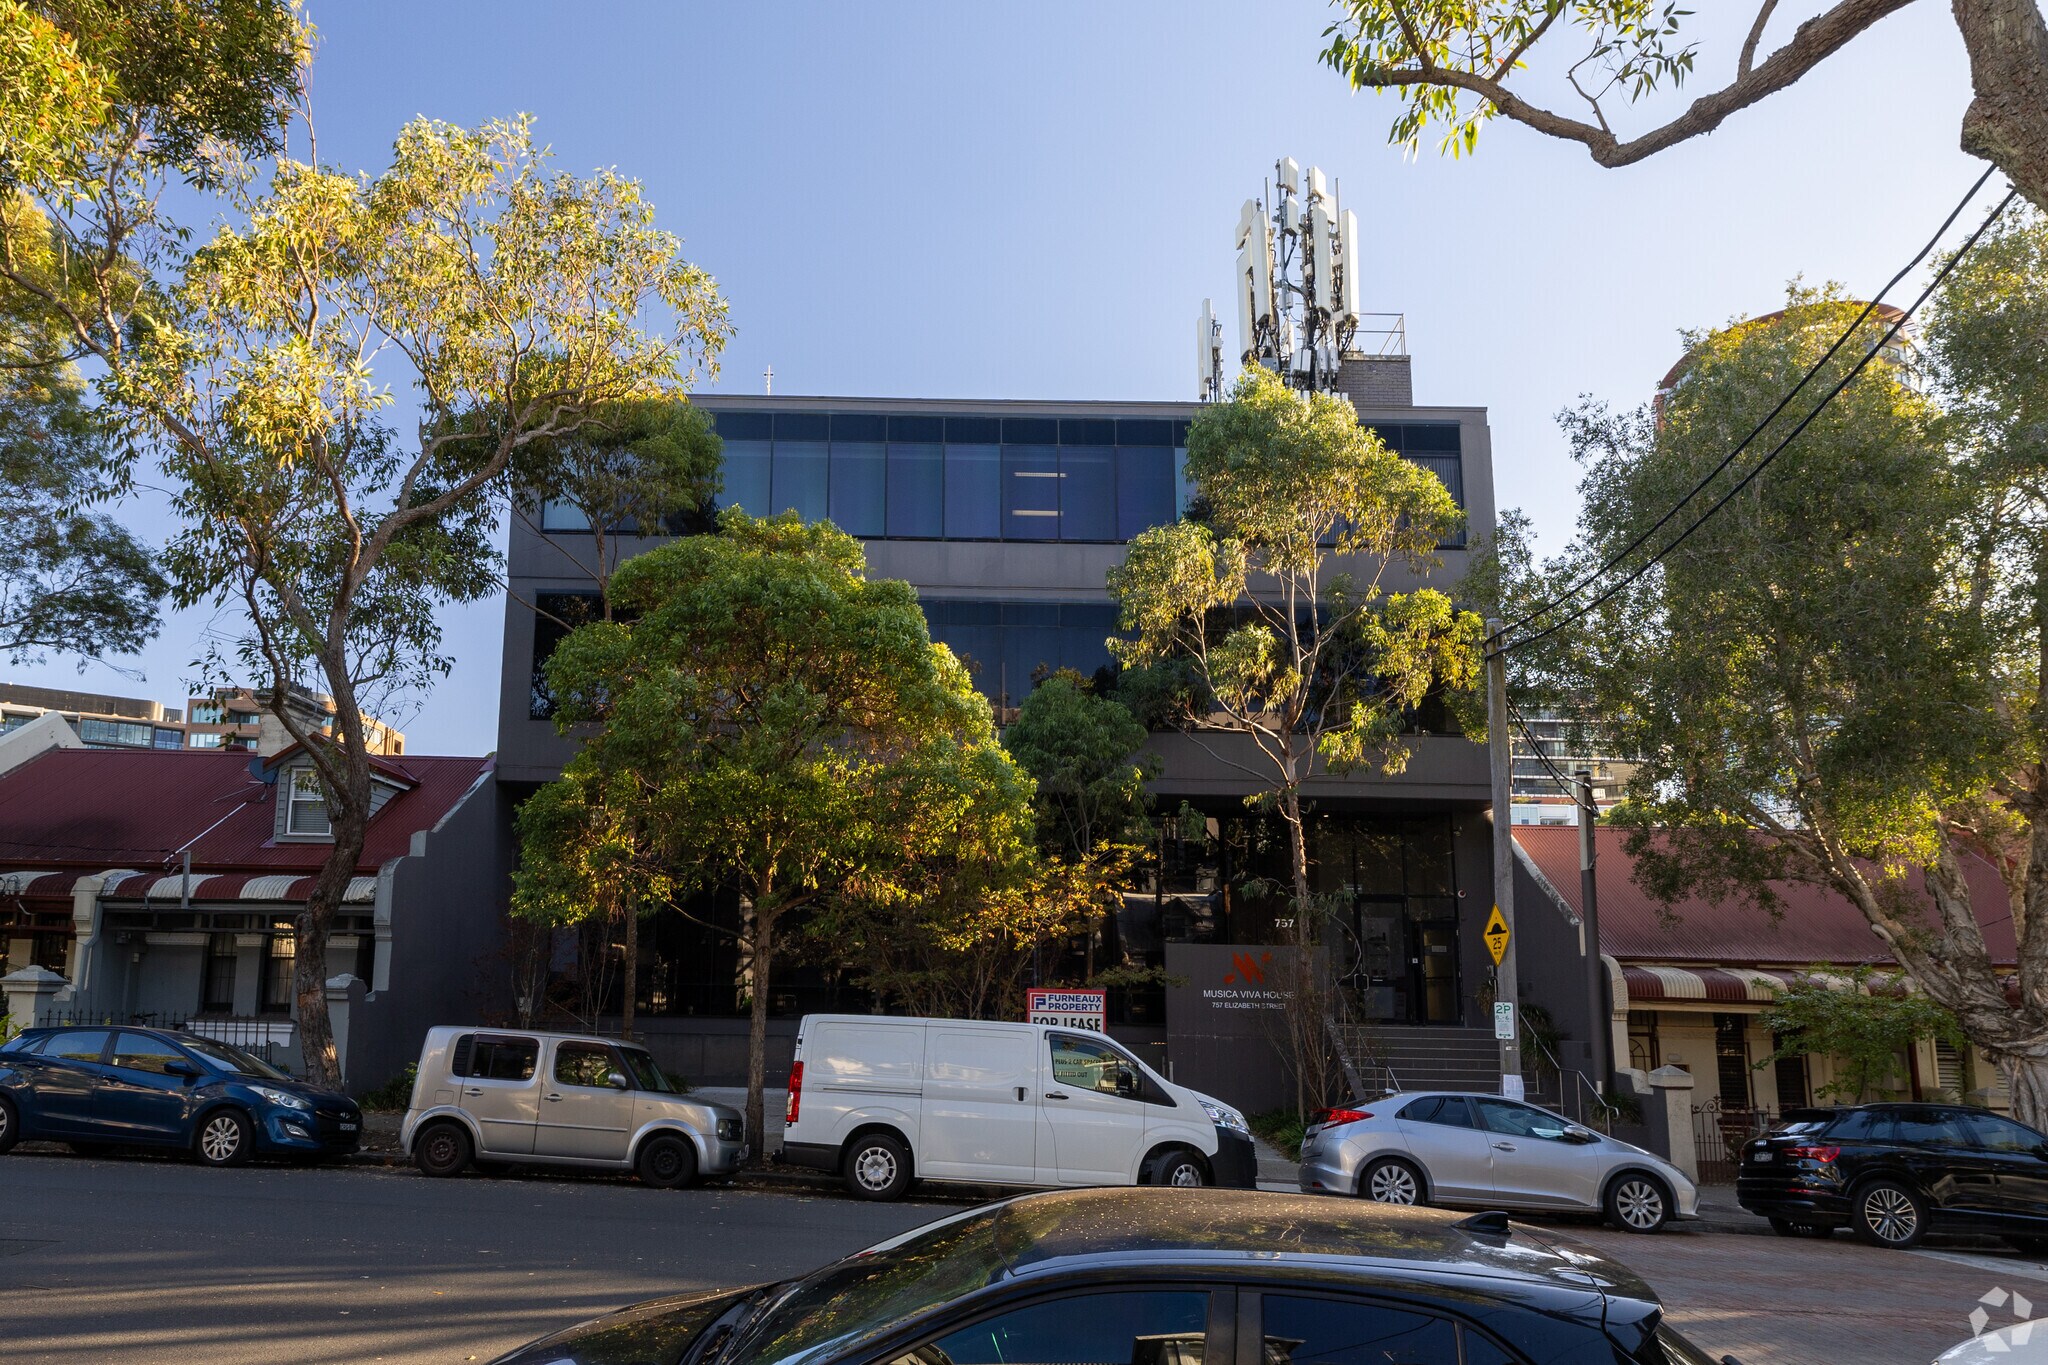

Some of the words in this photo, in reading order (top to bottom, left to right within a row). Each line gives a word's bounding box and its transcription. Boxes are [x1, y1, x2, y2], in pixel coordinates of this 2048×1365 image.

[1274, 918, 1294, 928] 757
[1493, 937, 1502, 950] 25
[1048, 994, 1102, 1003] FURNEAUX
[1203, 990, 1238, 998] MUSICA
[1240, 991, 1261, 999] VIVA
[1263, 991, 1295, 1000] HOUSE
[1048, 1002, 1101, 1011] PROPERTY
[1496, 1005, 1511, 1014] 2P
